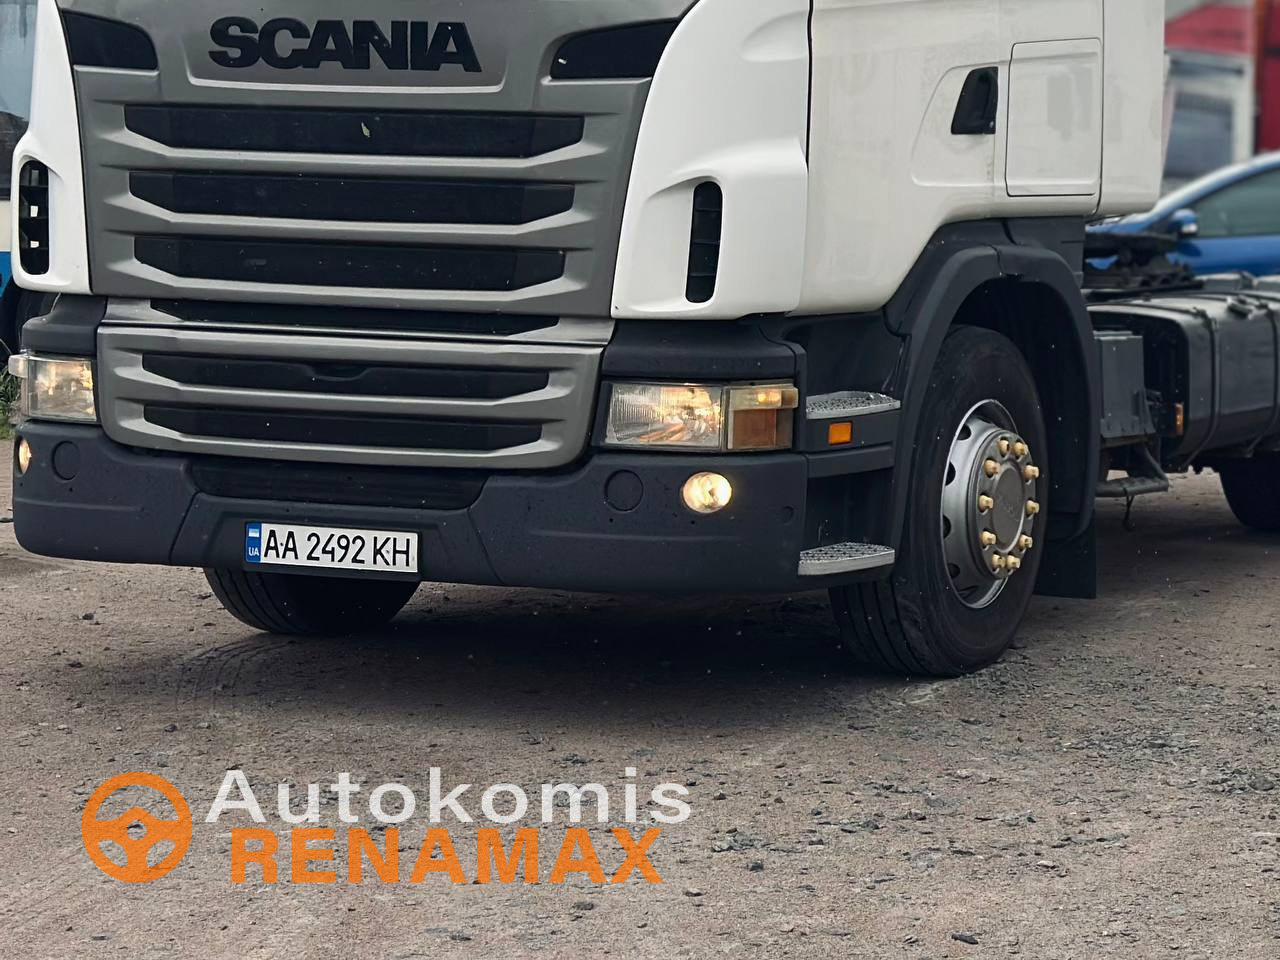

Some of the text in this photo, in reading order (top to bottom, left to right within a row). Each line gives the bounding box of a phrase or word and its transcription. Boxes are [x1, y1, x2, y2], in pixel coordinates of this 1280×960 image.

[208, 16, 482, 73] SCANIA
[248, 529, 411, 567] UA AA 2492 KH
